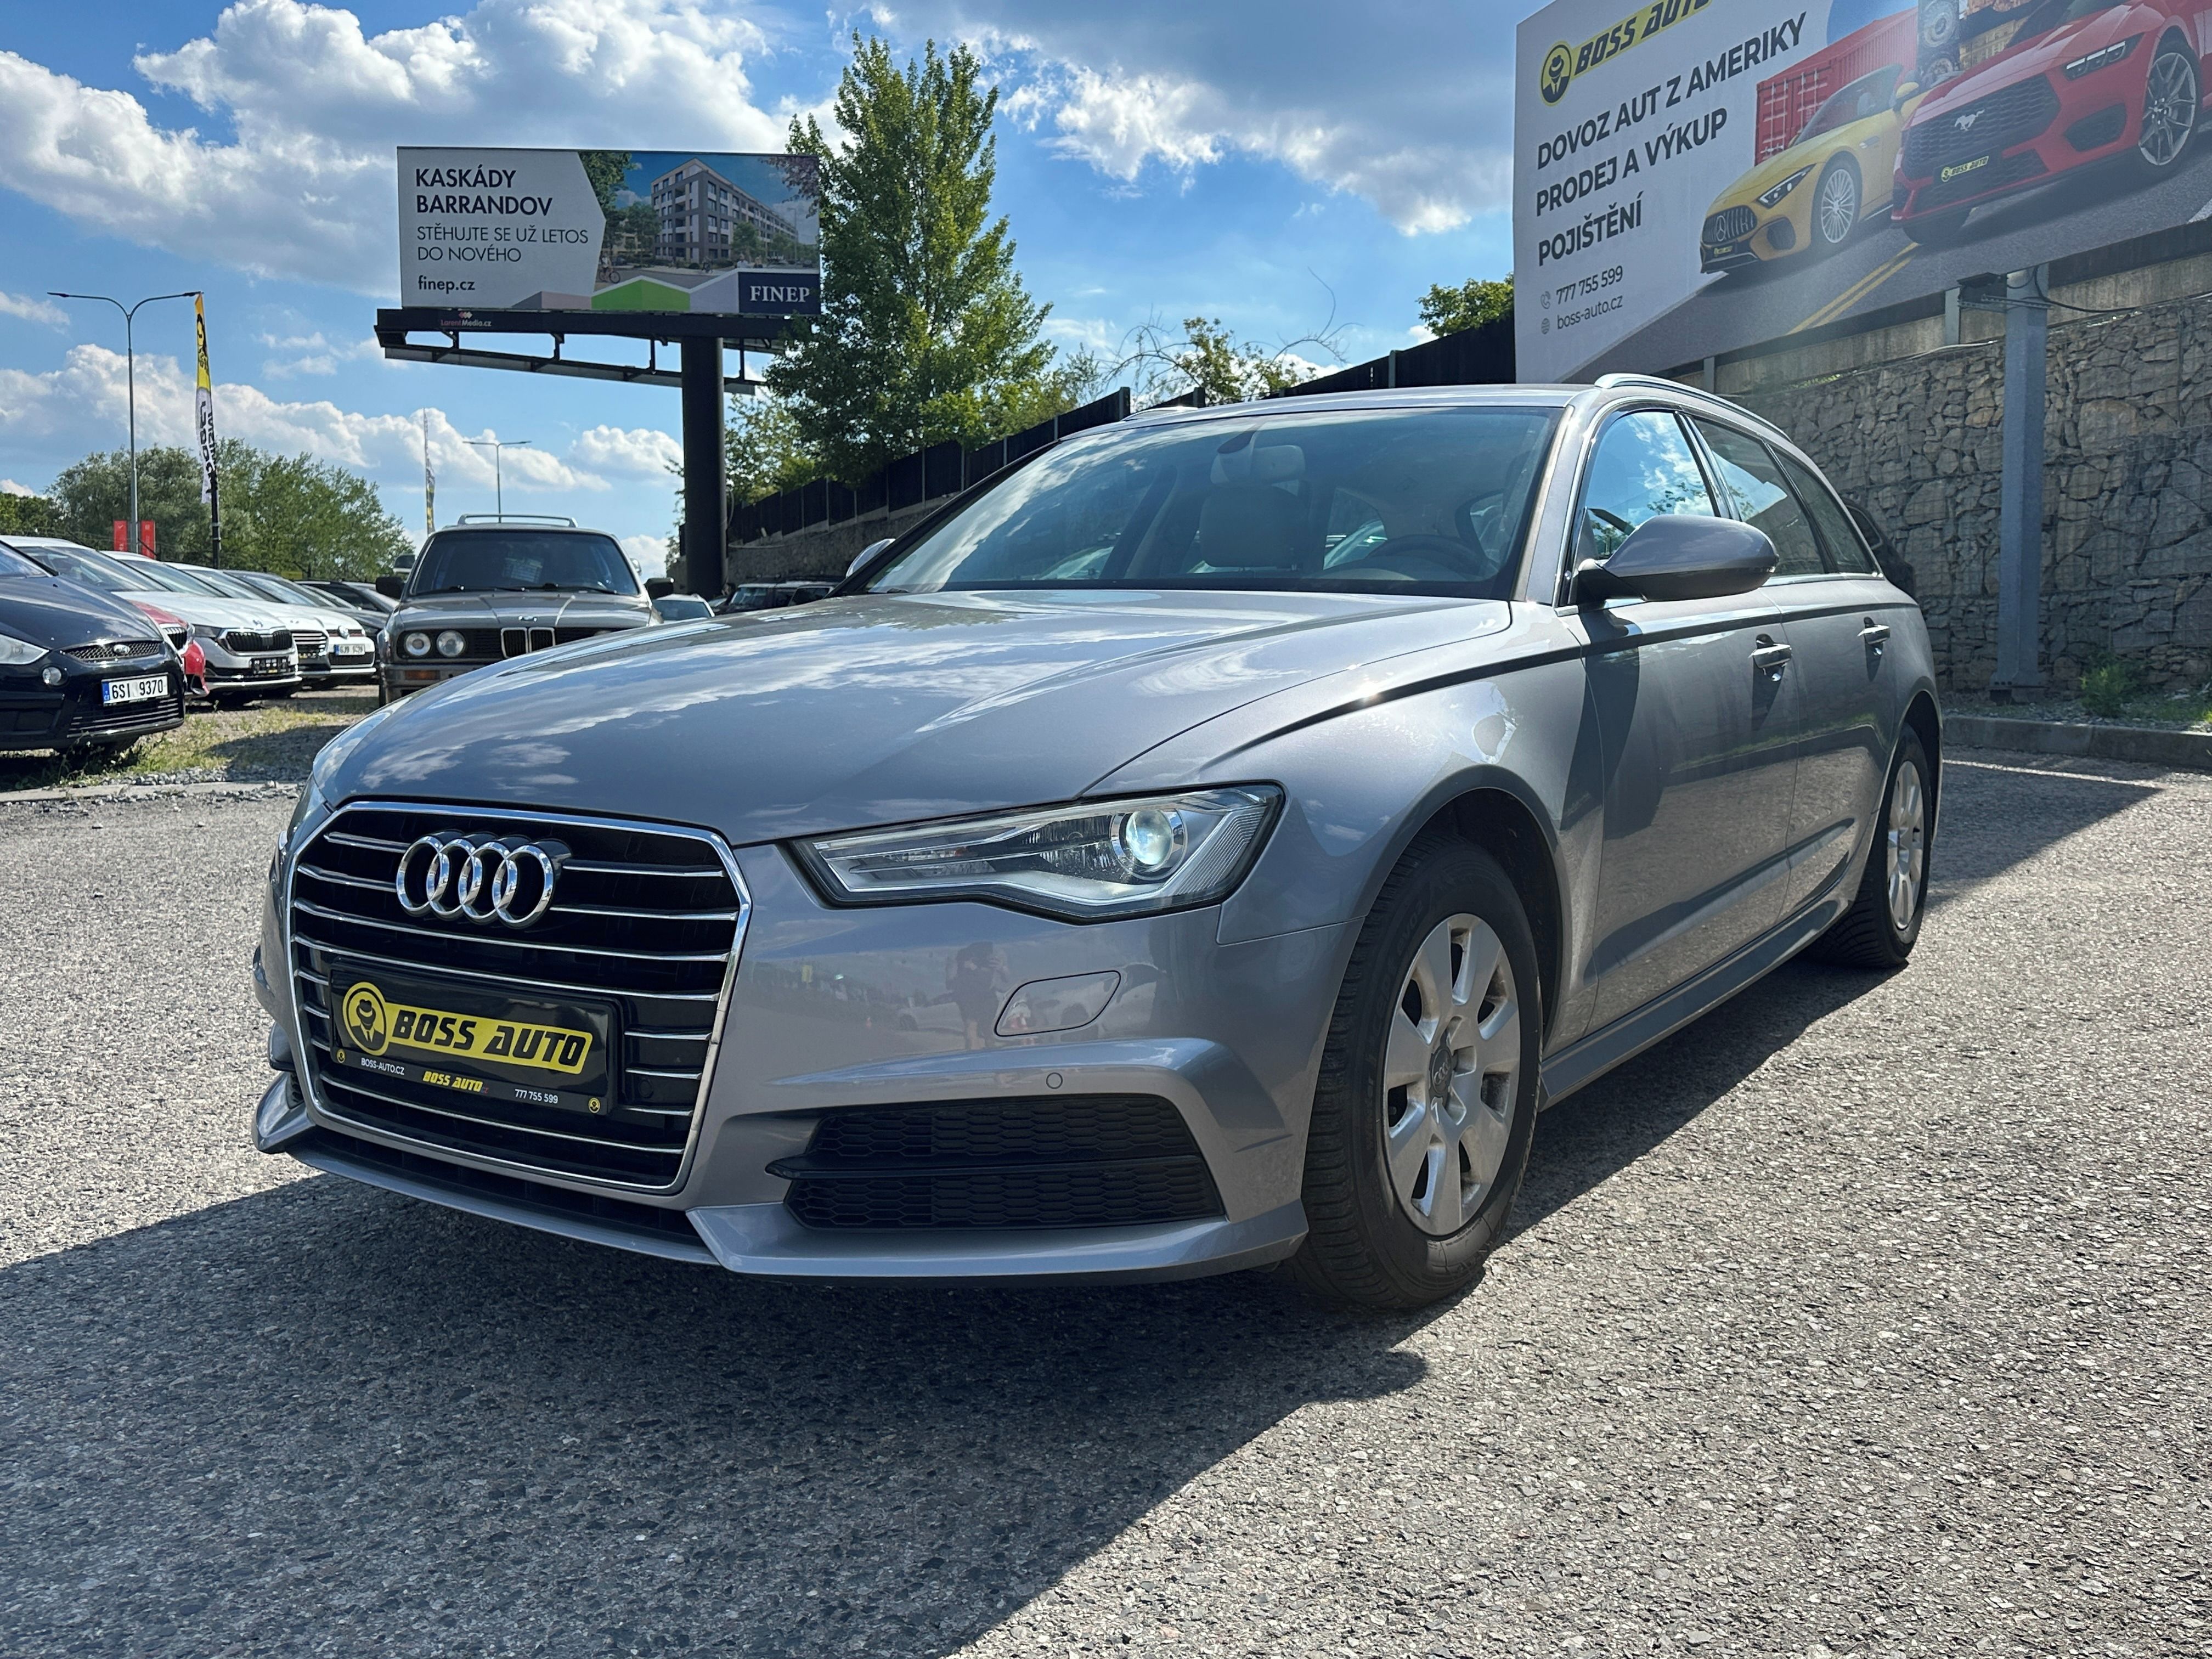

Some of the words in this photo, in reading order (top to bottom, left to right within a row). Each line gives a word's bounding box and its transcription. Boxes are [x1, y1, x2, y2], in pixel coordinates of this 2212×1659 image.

[1575, 16, 1637, 76] BOSS
[1538, 111, 1610, 170] DOVOZ
[1614, 86, 1661, 133] AUT
[1666, 76, 1681, 108] Z
[1686, 11, 1807, 99] AMERIKY
[1536, 156, 1618, 216] PRODEJ
[1622, 149, 1640, 178] A
[1645, 108, 1728, 167] VÝKUP
[415, 164, 516, 189] KASKÁDY
[416, 195, 552, 216] BARRANDOV
[417, 223, 488, 241] STĚHUJTE
[494, 227, 513, 242] SE
[516, 224, 537, 242] UŽ
[542, 229, 589, 244] LETOS
[1538, 190, 1644, 266] POJIŠTĚNÍ
[417, 246, 443, 261] DO
[448, 243, 522, 262] NOVÉHO
[417, 275, 476, 294] finep.cz
[749, 285, 810, 302] FINEP
[1556, 284, 1576, 304] 777
[1578, 274, 1599, 297] 755
[1601, 266, 1623, 289] 599
[1556, 295, 1623, 330] boss-auto.cz
[139, 679, 163, 696] 9370
[392, 1010, 477, 1049] BOSS
[483, 1025, 587, 1067] AUTO
[360, 1058, 405, 1075] BOSS-AUTO.CZ
[423, 1071, 451, 1086] BOSS
[452, 1077, 483, 1092] AUTO
[515, 1088, 528, 1099] 777
[528, 1091, 543, 1102] 755
[544, 1092, 558, 1104] 599
